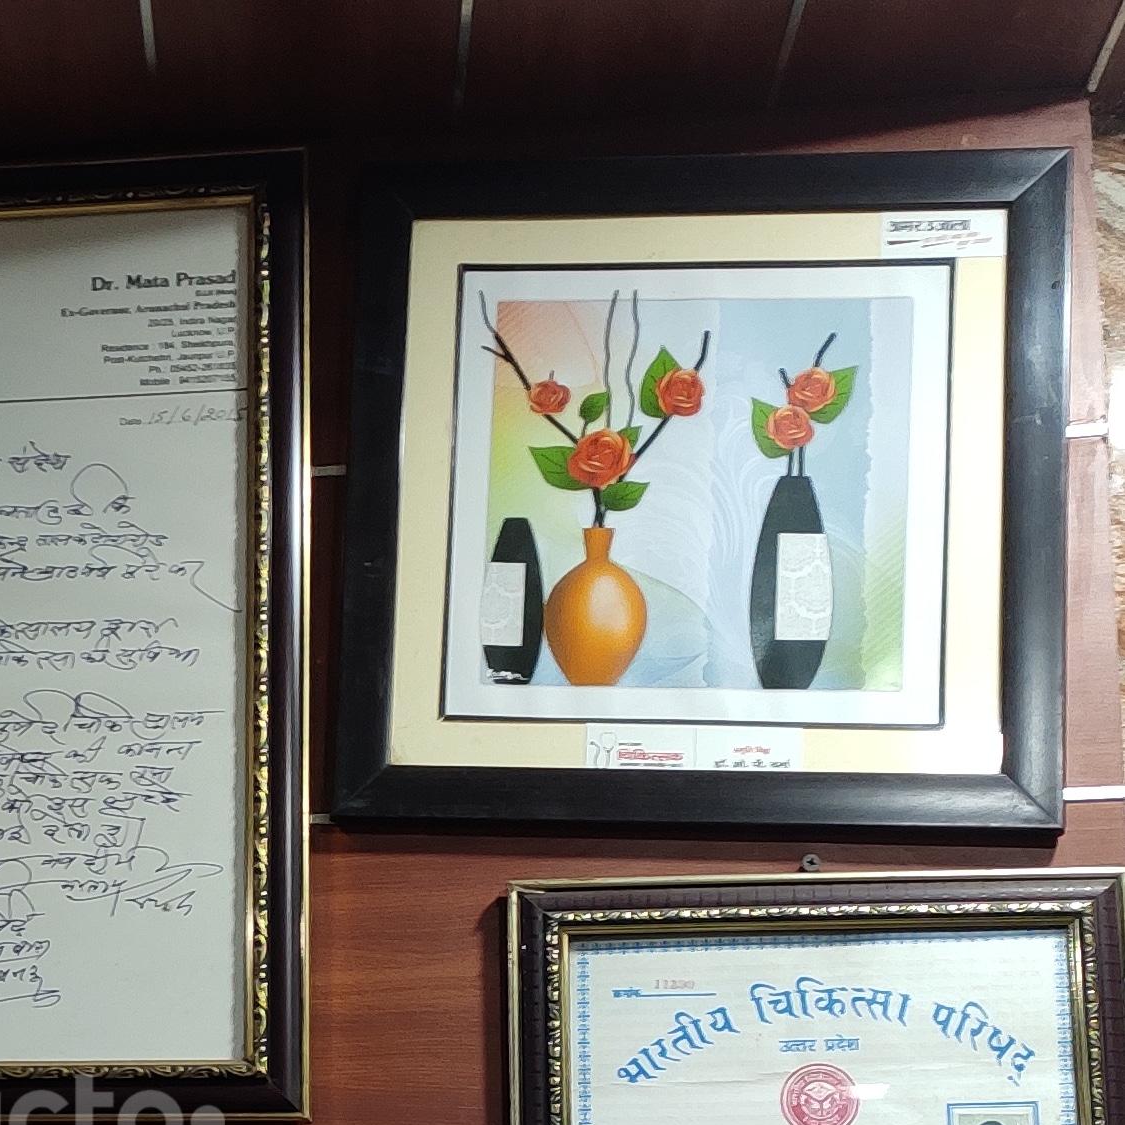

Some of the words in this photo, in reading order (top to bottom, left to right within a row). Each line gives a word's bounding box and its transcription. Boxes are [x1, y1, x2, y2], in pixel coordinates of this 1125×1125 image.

[91, 276, 119, 292] Dr.
[125, 274, 169, 290] Mata
[176, 269, 236, 287] Prasad
[616, 1006, 740, 1084] भारतीय
[749, 976, 911, 1026] चिकित्सा
[933, 1001, 1036, 1087] परिषद्
[779, 1039, 816, 1053] उत्तर
[824, 1036, 860, 1052] प्रदेश
